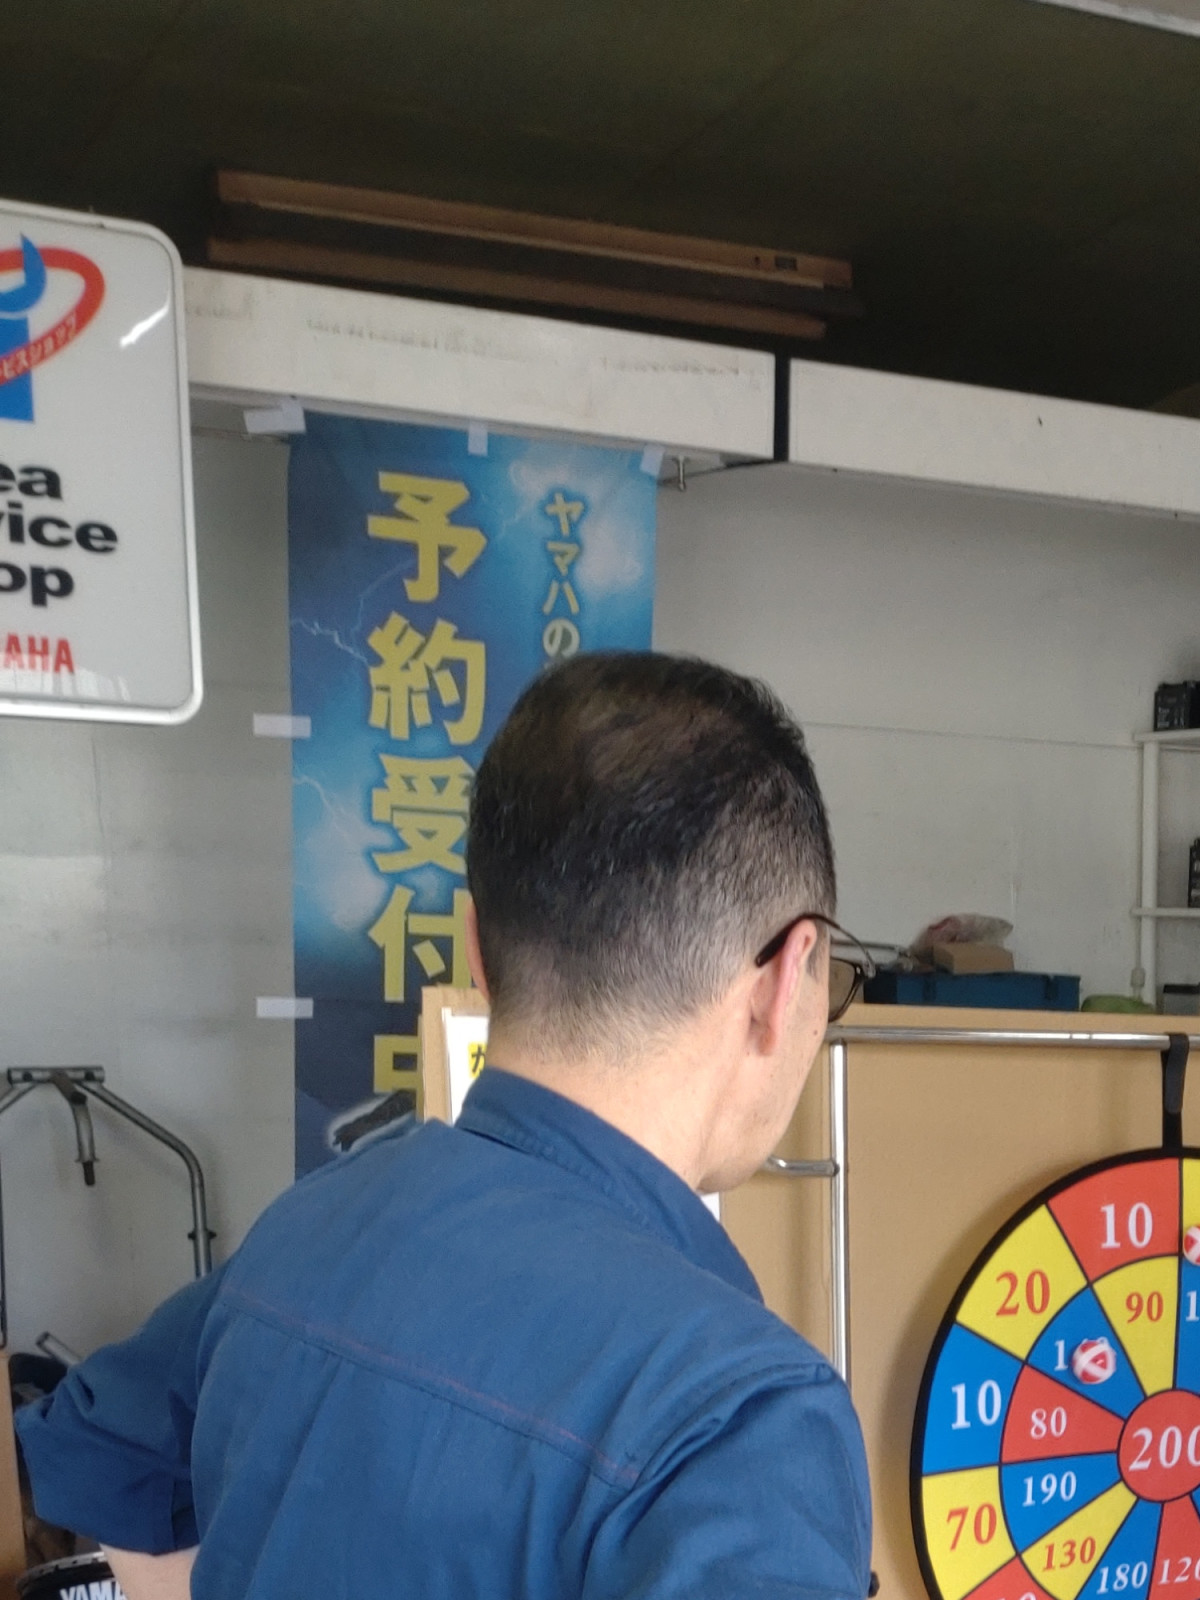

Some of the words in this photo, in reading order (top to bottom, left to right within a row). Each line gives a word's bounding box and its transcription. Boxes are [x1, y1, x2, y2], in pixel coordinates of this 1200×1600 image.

[1100, 1203, 1153, 1249] 10
[996, 1270, 1050, 1316] 20
[1126, 1292, 1164, 1323] 90
[951, 1380, 1001, 1429] 10
[1030, 1407, 1067, 1439] 80
[1023, 1472, 1077, 1507] 190
[947, 1503, 996, 1550] 70
[1043, 1537, 1096, 1571] 130
[1098, 1561, 1146, 1594] 180
